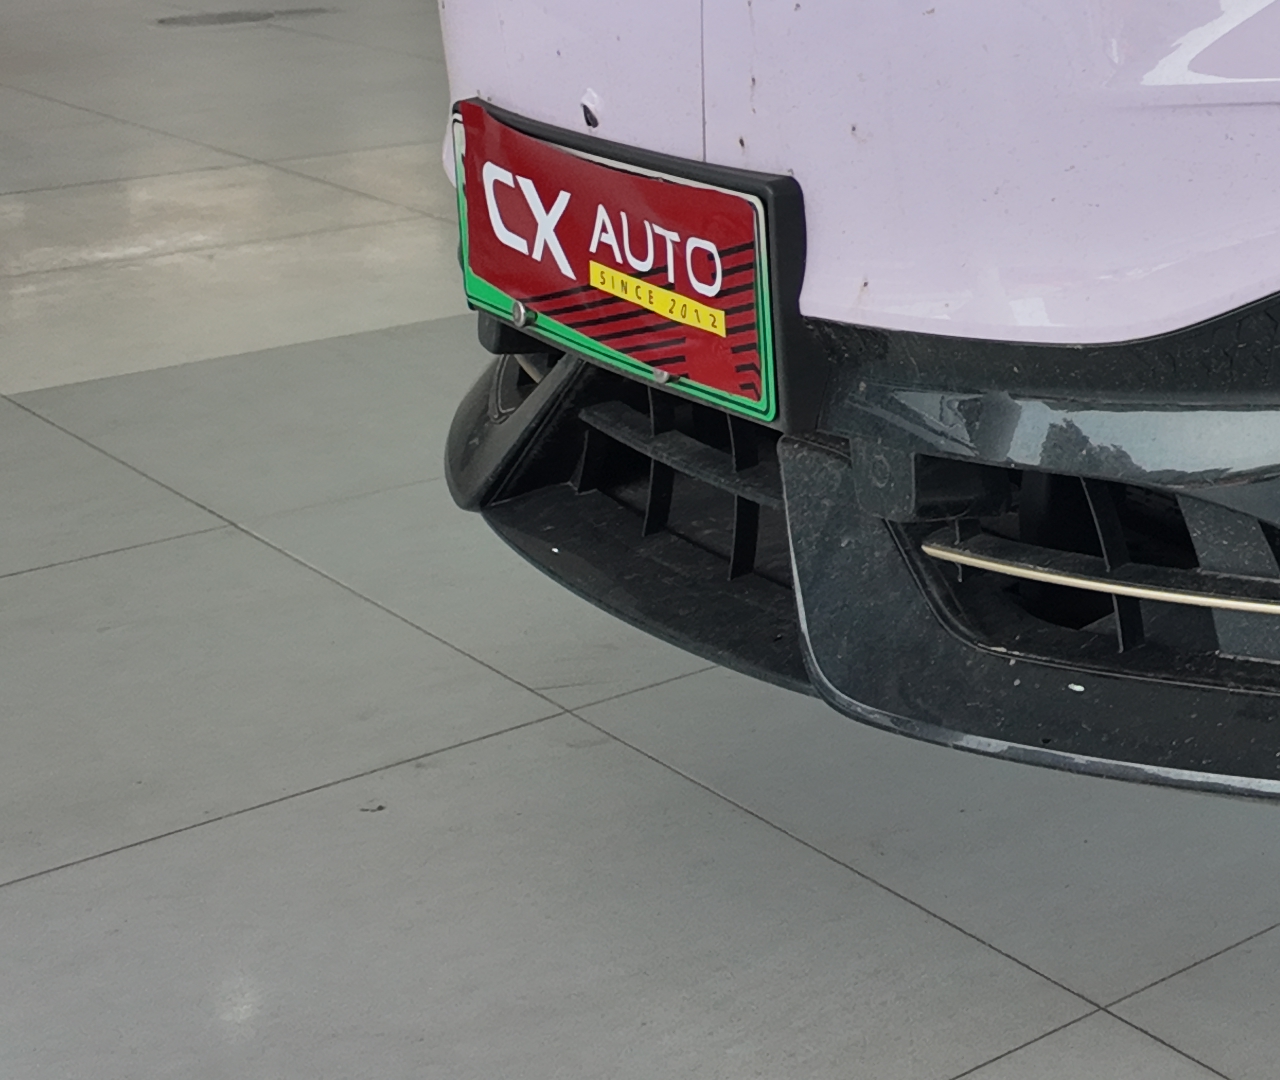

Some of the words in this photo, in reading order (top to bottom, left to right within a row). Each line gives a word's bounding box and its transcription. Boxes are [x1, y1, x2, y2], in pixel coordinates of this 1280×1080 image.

[482, 161, 577, 281] CX
[589, 203, 723, 298] AUTO
[599, 270, 656, 306] SINCE
[667, 298, 718, 329] 2012
